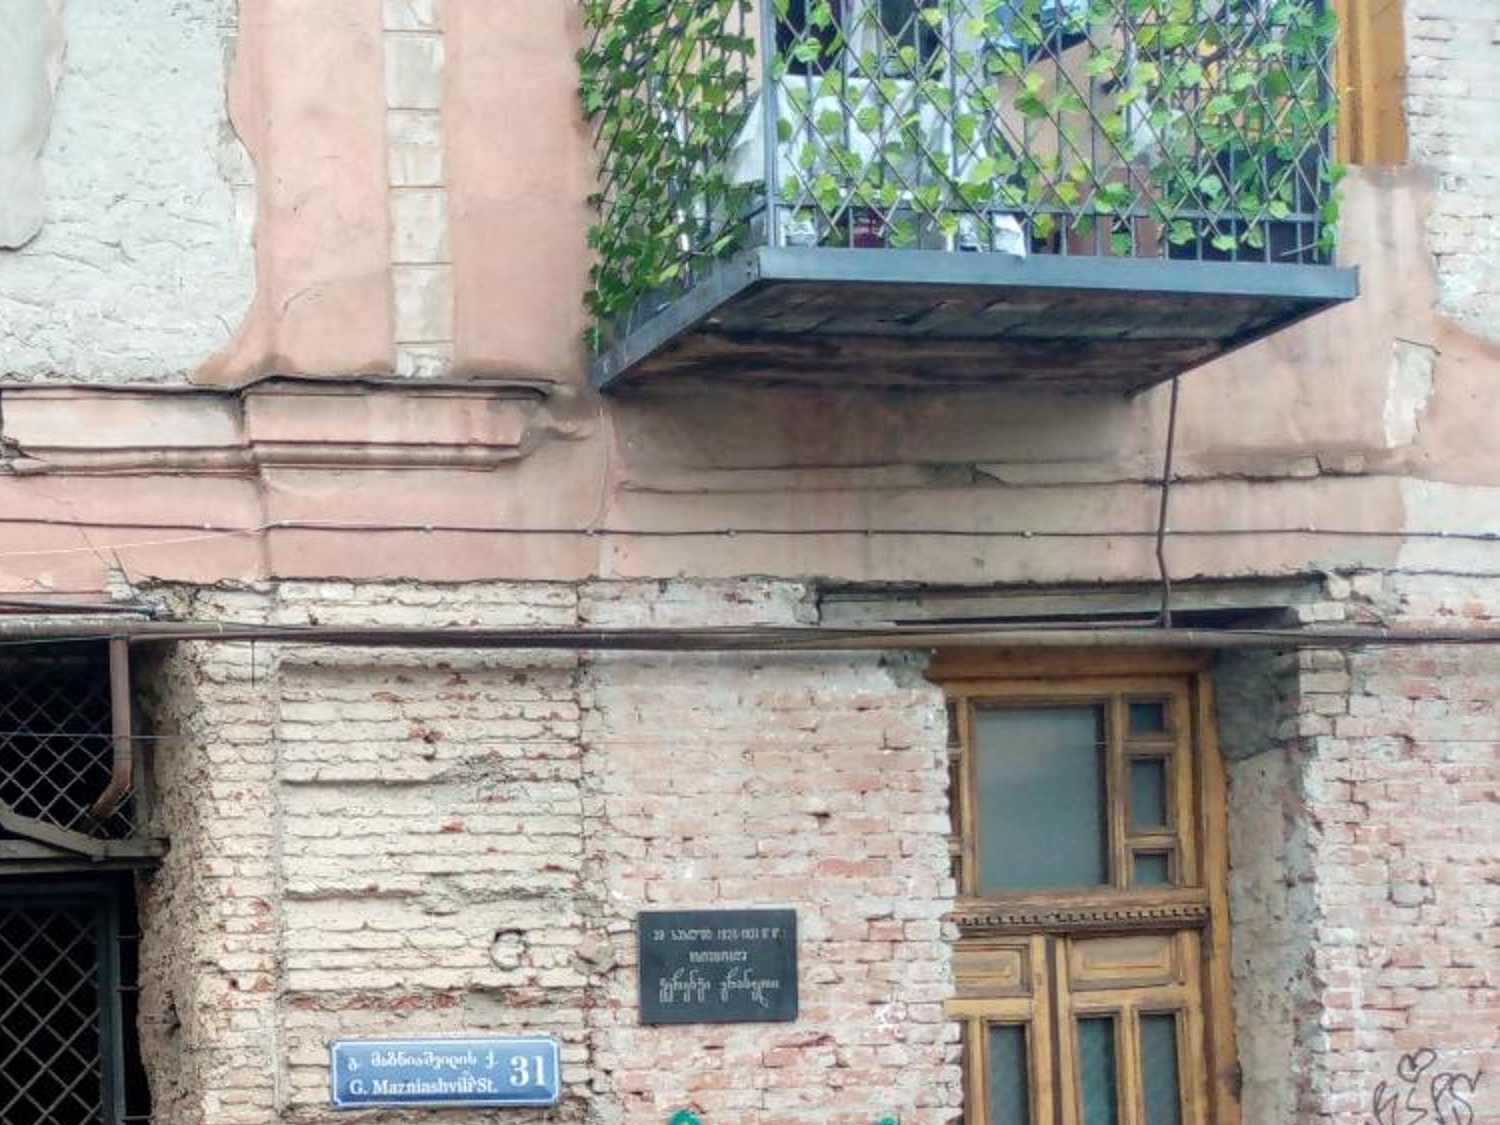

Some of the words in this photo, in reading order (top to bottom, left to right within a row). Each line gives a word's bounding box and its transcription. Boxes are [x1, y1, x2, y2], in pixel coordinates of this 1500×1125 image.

[510, 1055, 545, 1087] 31
[350, 1079, 367, 1095] G.
[475, 1076, 498, 1094] St.
